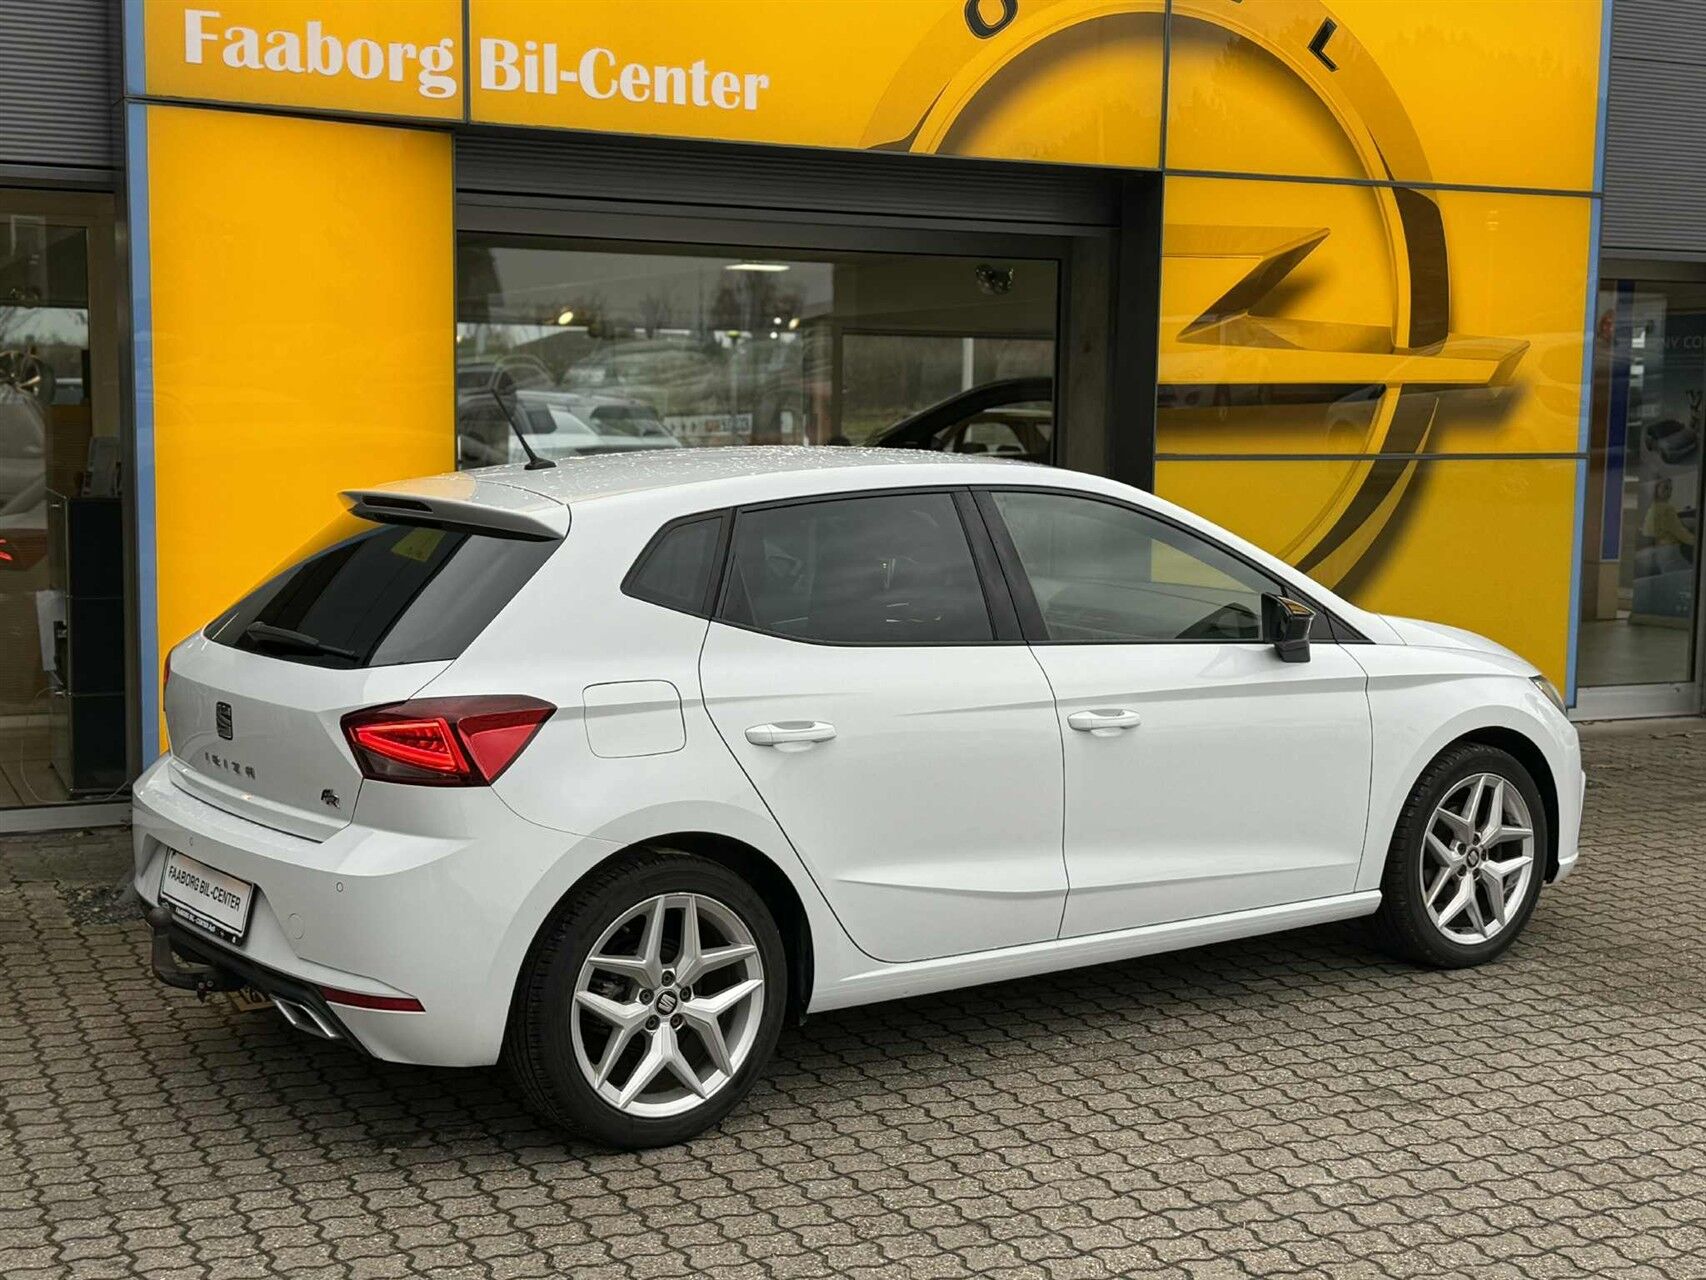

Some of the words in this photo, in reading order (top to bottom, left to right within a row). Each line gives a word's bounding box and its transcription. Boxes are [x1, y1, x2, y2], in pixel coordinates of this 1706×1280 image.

[184, 8, 458, 99] Faaborg
[479, 37, 770, 111] Bil-Center
[168, 865, 200, 891] FAABORG
[199, 879, 242, 912] BIL-CENTER
